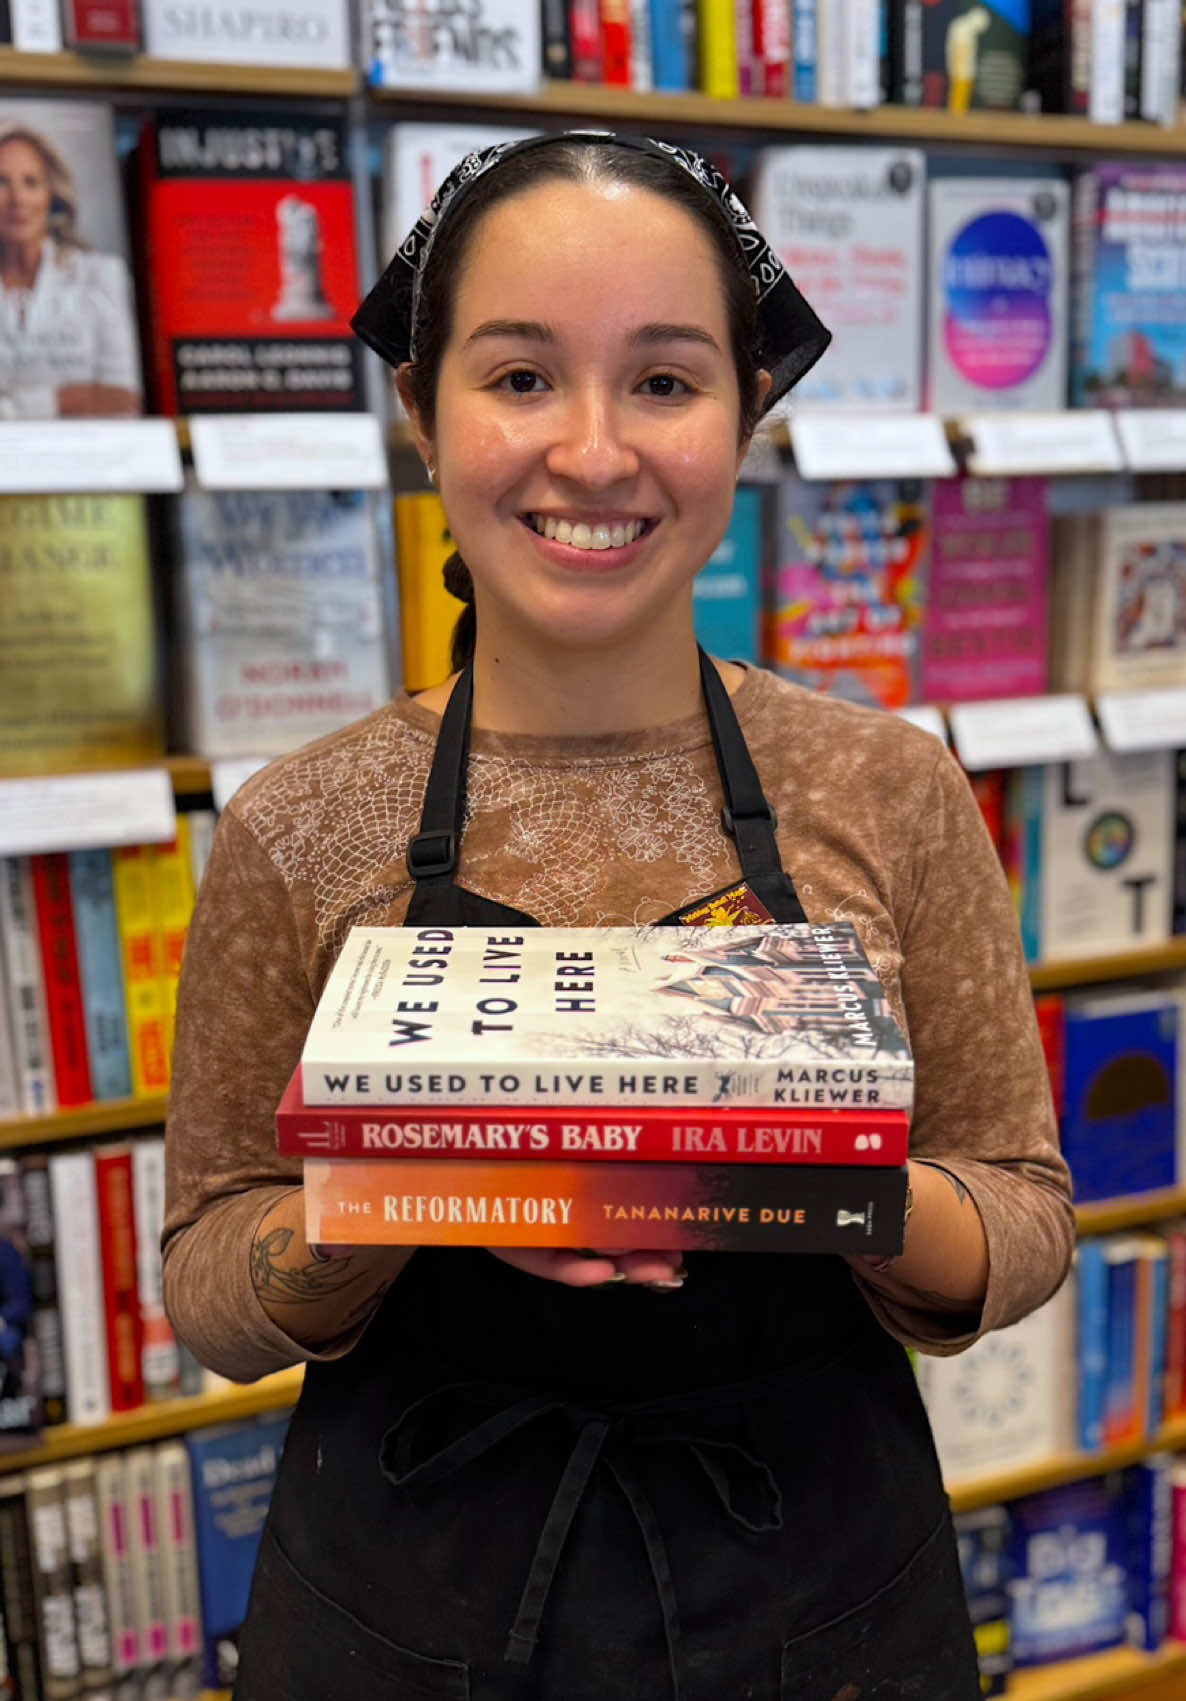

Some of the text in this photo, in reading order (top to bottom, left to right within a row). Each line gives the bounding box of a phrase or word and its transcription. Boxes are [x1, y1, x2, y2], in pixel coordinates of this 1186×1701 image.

[389, 928, 454, 1047] WE USED
[472, 936, 524, 1036] TO LIVE
[554, 951, 596, 1013] HERE
[834, 984, 878, 1046] MARCUS
[324, 1074, 698, 1094] WE USED TO LIVE HERE
[777, 1069, 879, 1084] MARCUS
[773, 1088, 881, 1104] KLIEWER
[361, 1122, 550, 1150] ROSEMARY'S
[561, 1124, 643, 1151] BABY
[671, 1126, 728, 1152] IRA
[736, 1127, 823, 1154] LEVIN
[337, 1195, 574, 1225] THE REFORMATORY
[602, 1204, 807, 1225] TANANARIVE DUE
